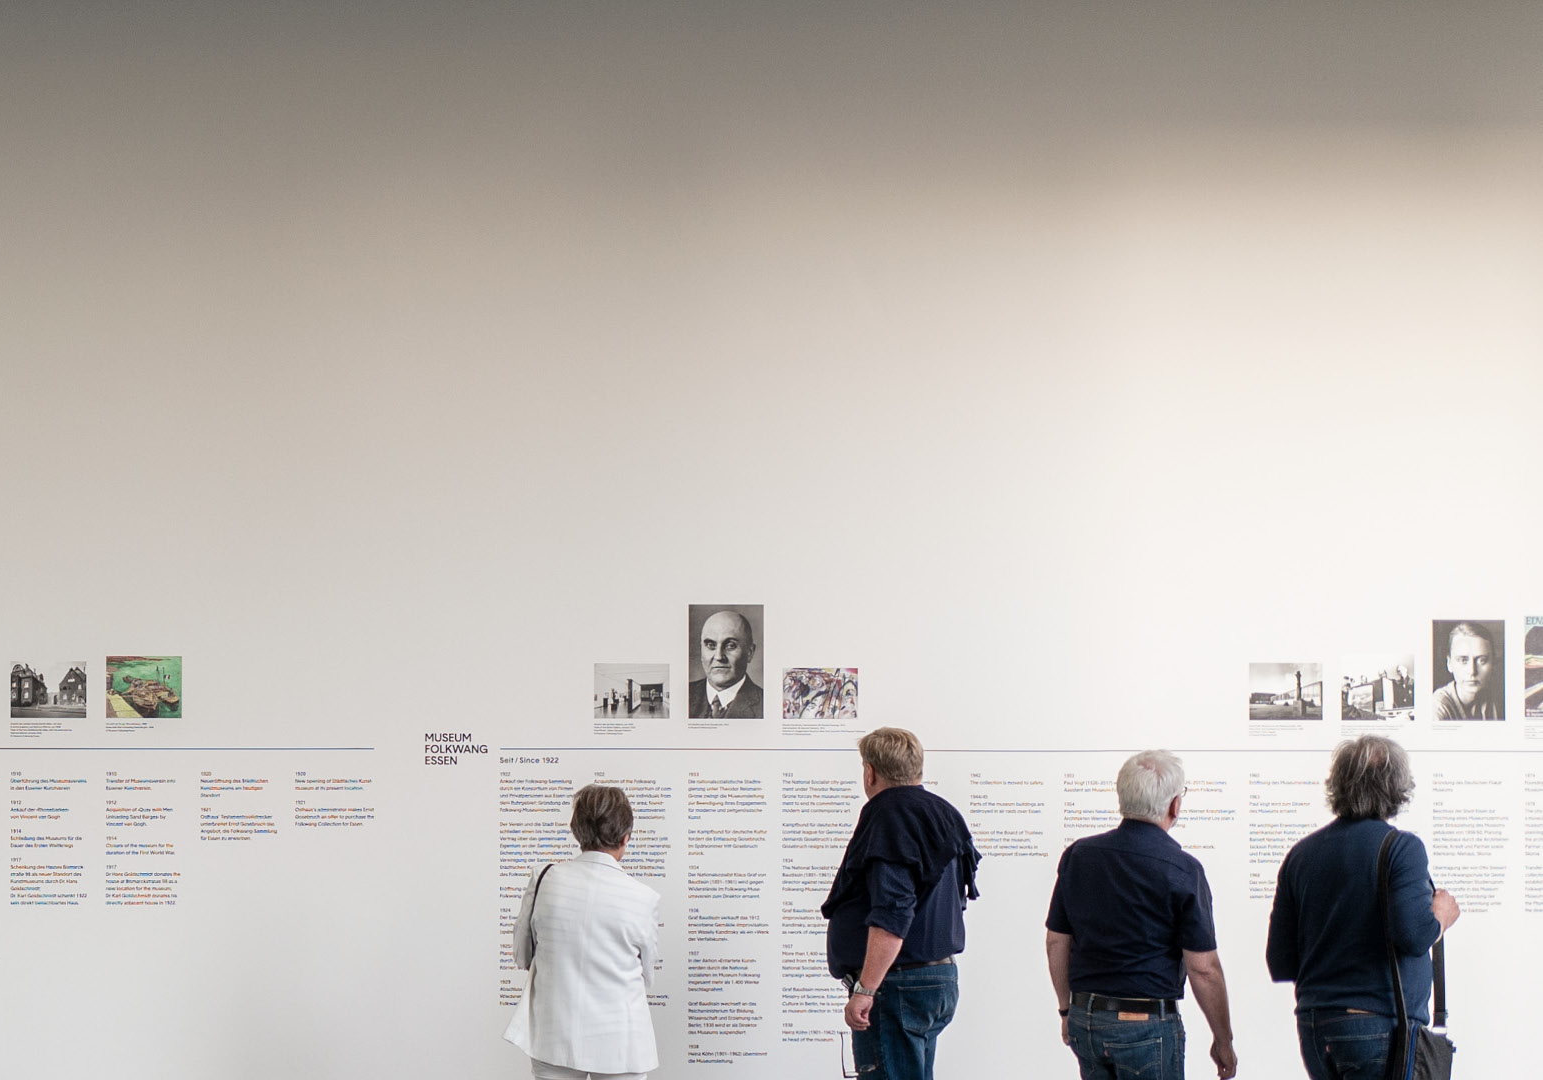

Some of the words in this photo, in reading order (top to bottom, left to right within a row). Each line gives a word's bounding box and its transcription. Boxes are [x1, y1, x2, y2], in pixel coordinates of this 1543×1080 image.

[1525, 616, 1543, 625] EDV
[424, 733, 472, 743] MUSEUM
[424, 744, 489, 754] FOLKWANG
[424, 756, 458, 765] ESSEN
[499, 756, 514, 764] Seit
[519, 756, 540, 764] Since
[542, 756, 560, 764] 1922
